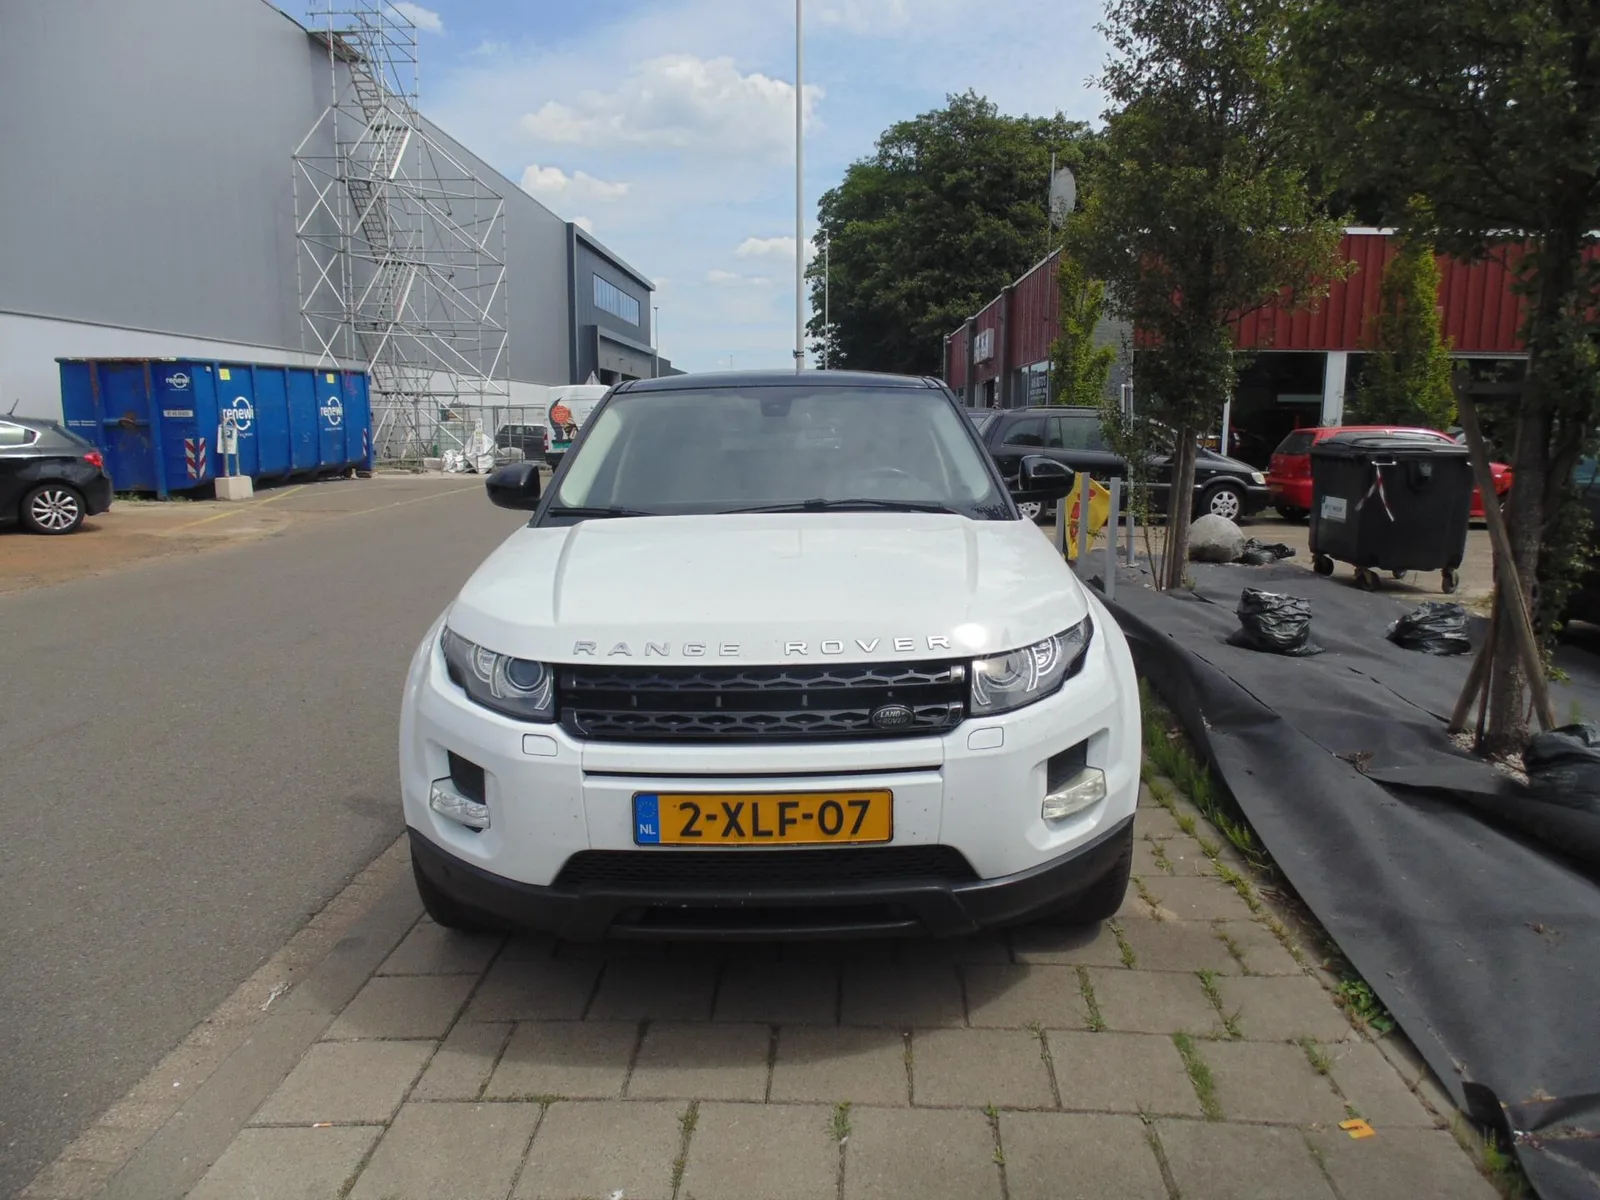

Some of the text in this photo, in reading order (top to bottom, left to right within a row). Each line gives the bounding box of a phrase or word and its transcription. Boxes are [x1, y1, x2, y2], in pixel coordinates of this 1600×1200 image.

[222, 404, 254, 420] renewi
[320, 403, 343, 417] renewi
[573, 634, 951, 657] RANGE ROVER
[880, 710, 901, 718] LAND
[881, 717, 908, 725] ROVER
[679, 800, 871, 837] 2-XLF-07
[639, 824, 656, 835] NL
